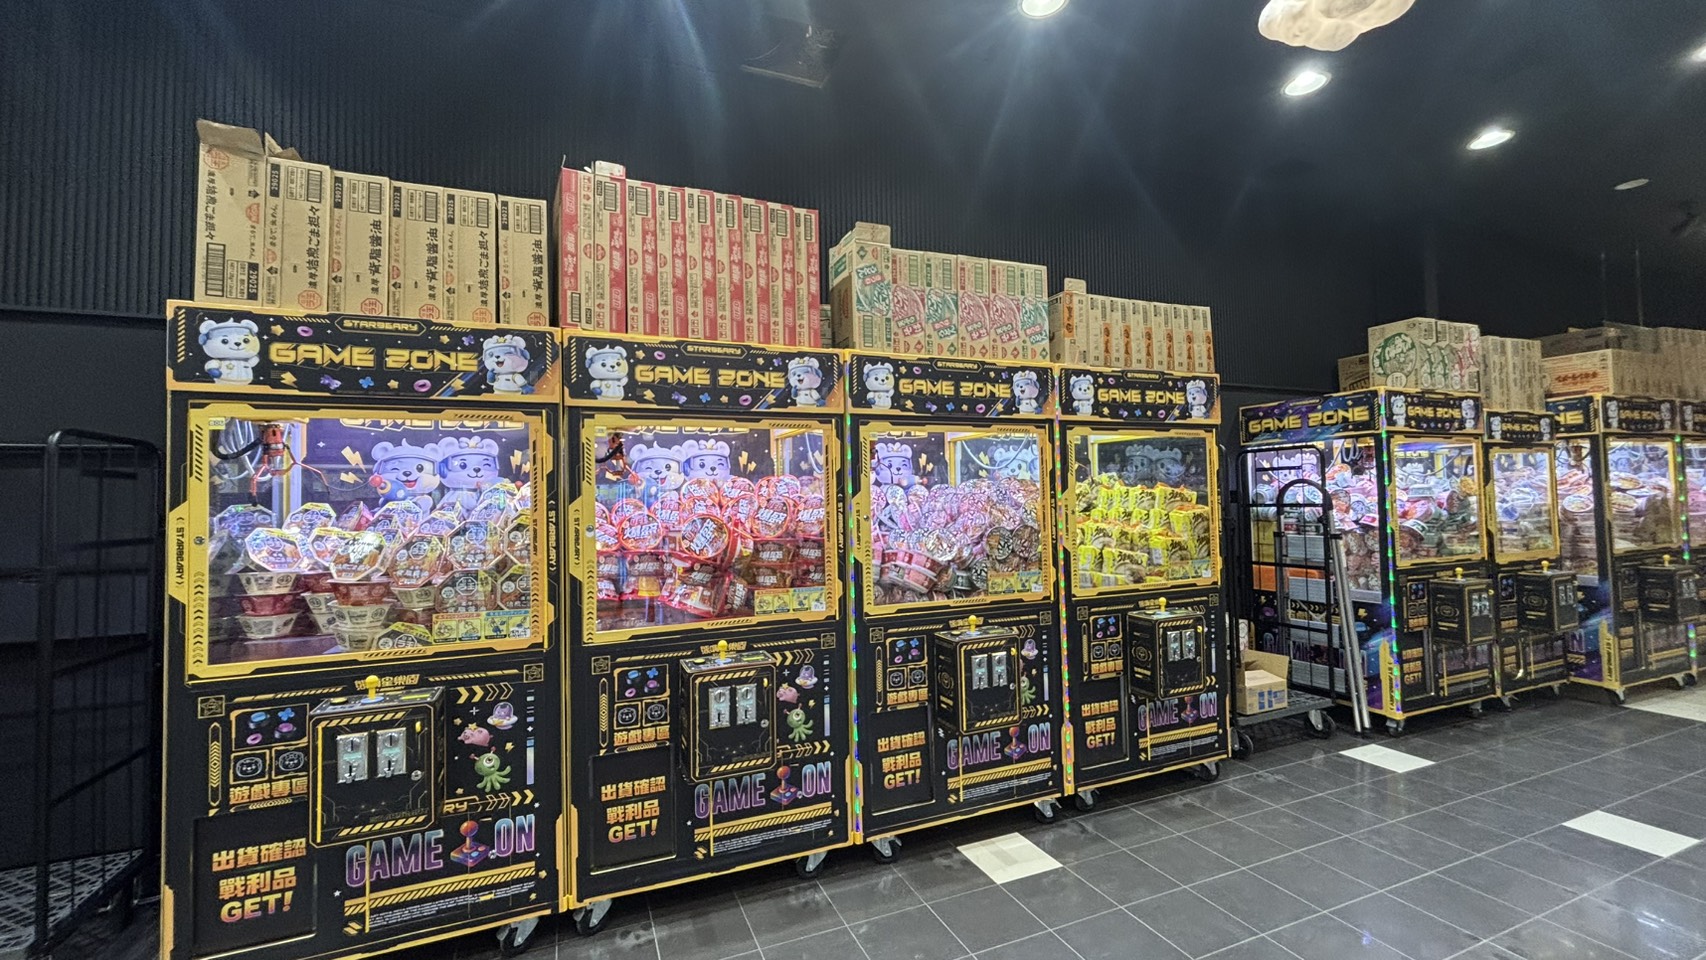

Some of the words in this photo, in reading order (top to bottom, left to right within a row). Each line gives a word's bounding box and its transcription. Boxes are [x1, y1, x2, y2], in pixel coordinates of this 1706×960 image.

[270, 170, 280, 190] 29025
[248, 269, 258, 294] 29025
[342, 319, 418, 332] STARBEARY
[269, 342, 375, 370] GAME
[384, 348, 480, 373] ZONE
[686, 345, 741, 355] STARBEARY
[634, 365, 711, 386] GAME
[717, 369, 787, 389] ZONE
[899, 378, 955, 396] GAME
[960, 381, 1013, 399] ZONE
[1097, 388, 1142, 404] GAME
[1145, 389, 1187, 405] ZONE
[1248, 414, 1302, 434] GAME
[1308, 405, 1370, 427] ZONE
[1408, 405, 1436, 418] GAME
[1437, 405, 1462, 419] ZONE
[1502, 422, 1524, 432] GAME
[1525, 422, 1540, 432] ZONE
[755, 507, 787, 524] 爆盛
[548, 510, 557, 565] STARBEARY
[176, 526, 184, 579] STARBEARY
[1570, 629, 1584, 654] N
[354, 674, 420, 691] 星樂園
[1137, 698, 1179, 732] GAME
[1199, 691, 1218, 719] ON
[614, 727, 670, 746] 遊戲專區
[877, 731, 926, 753] 出貨確認
[947, 731, 1001, 770] GAME
[1027, 722, 1051, 754] ON
[1086, 732, 1116, 750] GET!
[882, 751, 922, 773] 戰利品
[229, 777, 308, 805] 遊戲專區
[600, 776, 666, 802] 出貨確認
[694, 772, 766, 820] GAME
[801, 761, 832, 798] ON
[884, 768, 921, 790] GET!
[442, 801, 468, 815] RY
[606, 799, 660, 825] 戰利品
[608, 819, 658, 844] GET!
[212, 837, 307, 872] 出貨確認
[345, 829, 445, 888] GAME
[494, 813, 536, 858] ON
[219, 866, 297, 900] 戰利品
[220, 891, 294, 923] GET!
